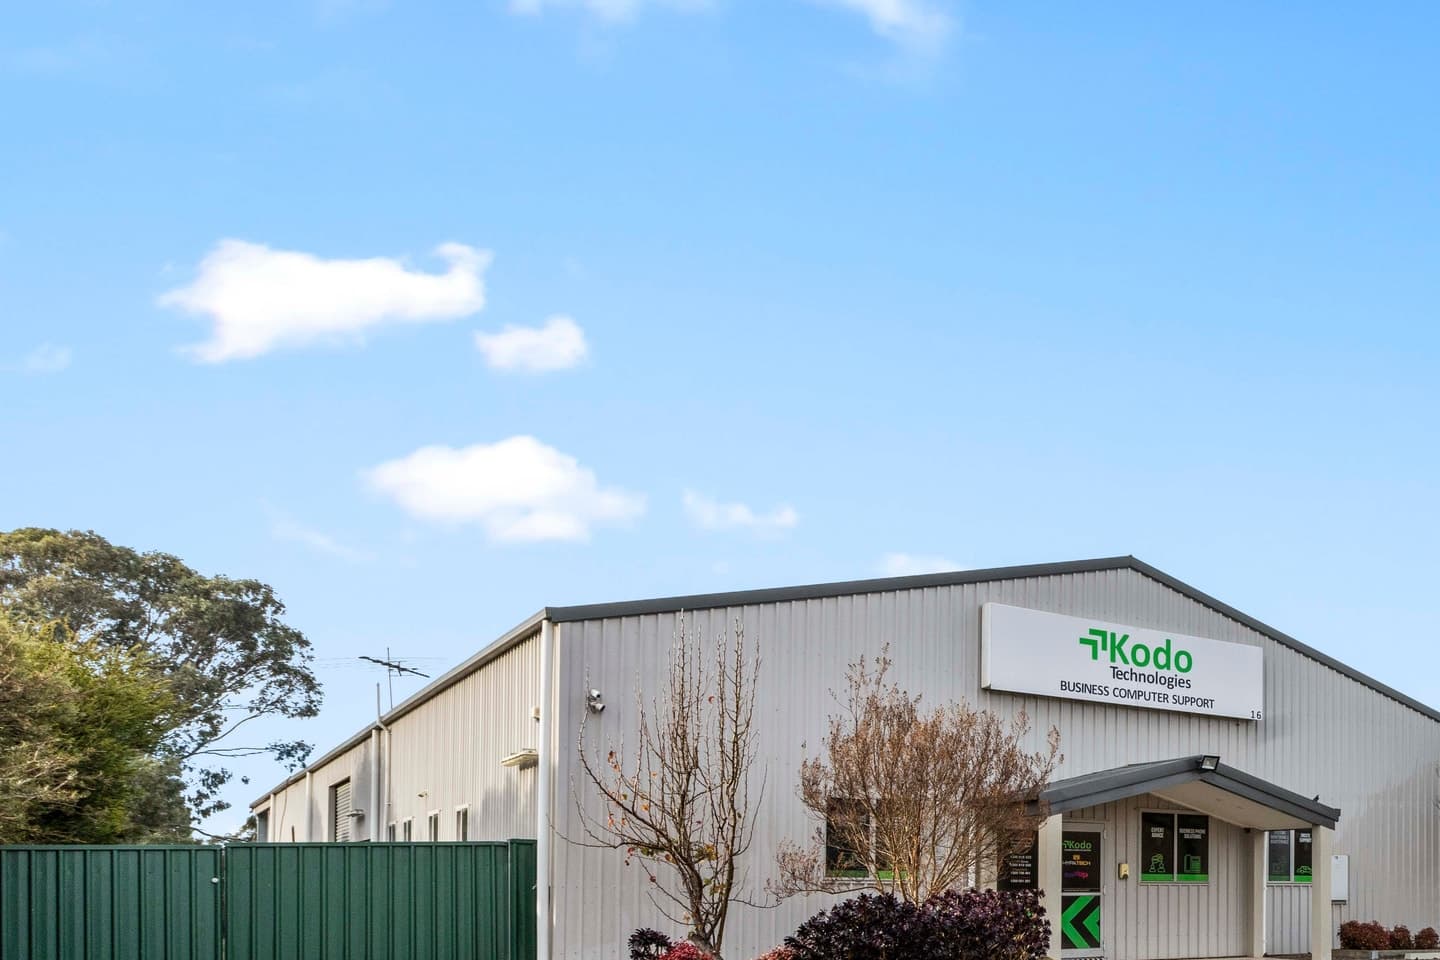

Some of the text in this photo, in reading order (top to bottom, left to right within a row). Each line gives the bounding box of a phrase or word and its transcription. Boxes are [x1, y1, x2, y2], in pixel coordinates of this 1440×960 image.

[1110, 631, 1193, 673] Kodo
[1110, 665, 1192, 690] Technologies
[1060, 680, 1215, 709] BUSINESS COMPUTER SUPPORT
[1250, 710, 1262, 720] 16
[1069, 840, 1092, 849] Kodo
